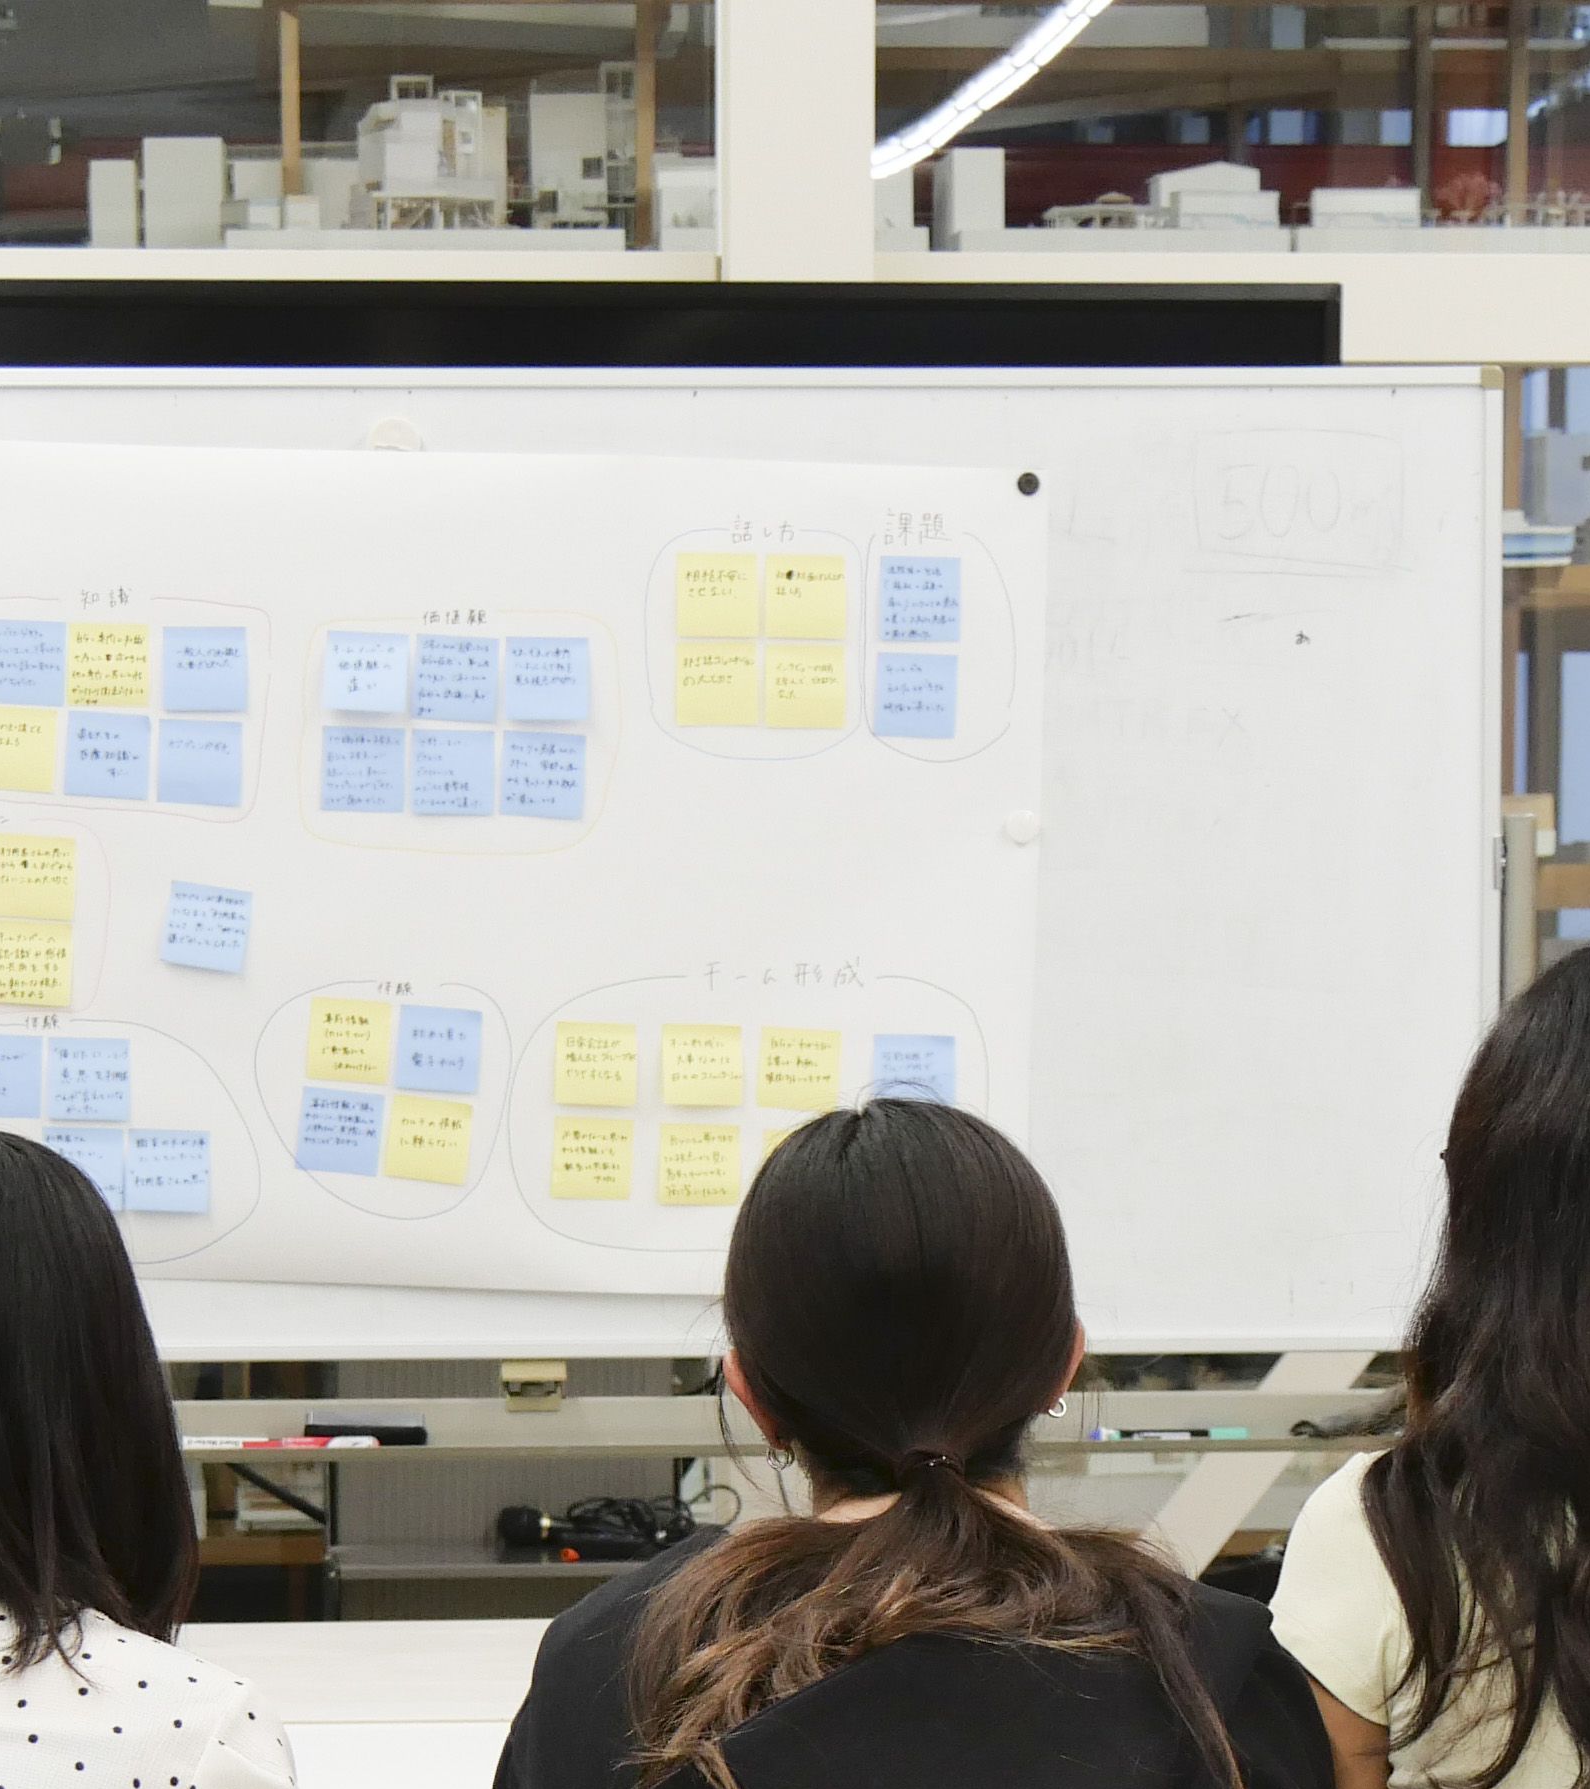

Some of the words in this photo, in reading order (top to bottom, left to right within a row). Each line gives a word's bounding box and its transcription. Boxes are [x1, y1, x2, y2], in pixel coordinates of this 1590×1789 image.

[731, 514, 795, 543] 話し方
[884, 507, 953, 547] 課題
[81, 587, 132, 610] 知識
[421, 609, 488, 628] 価値観
[703, 956, 866, 991] チーム形成
[377, 980, 415, 997] 体験
[23, 1014, 60, 1031] 体験
